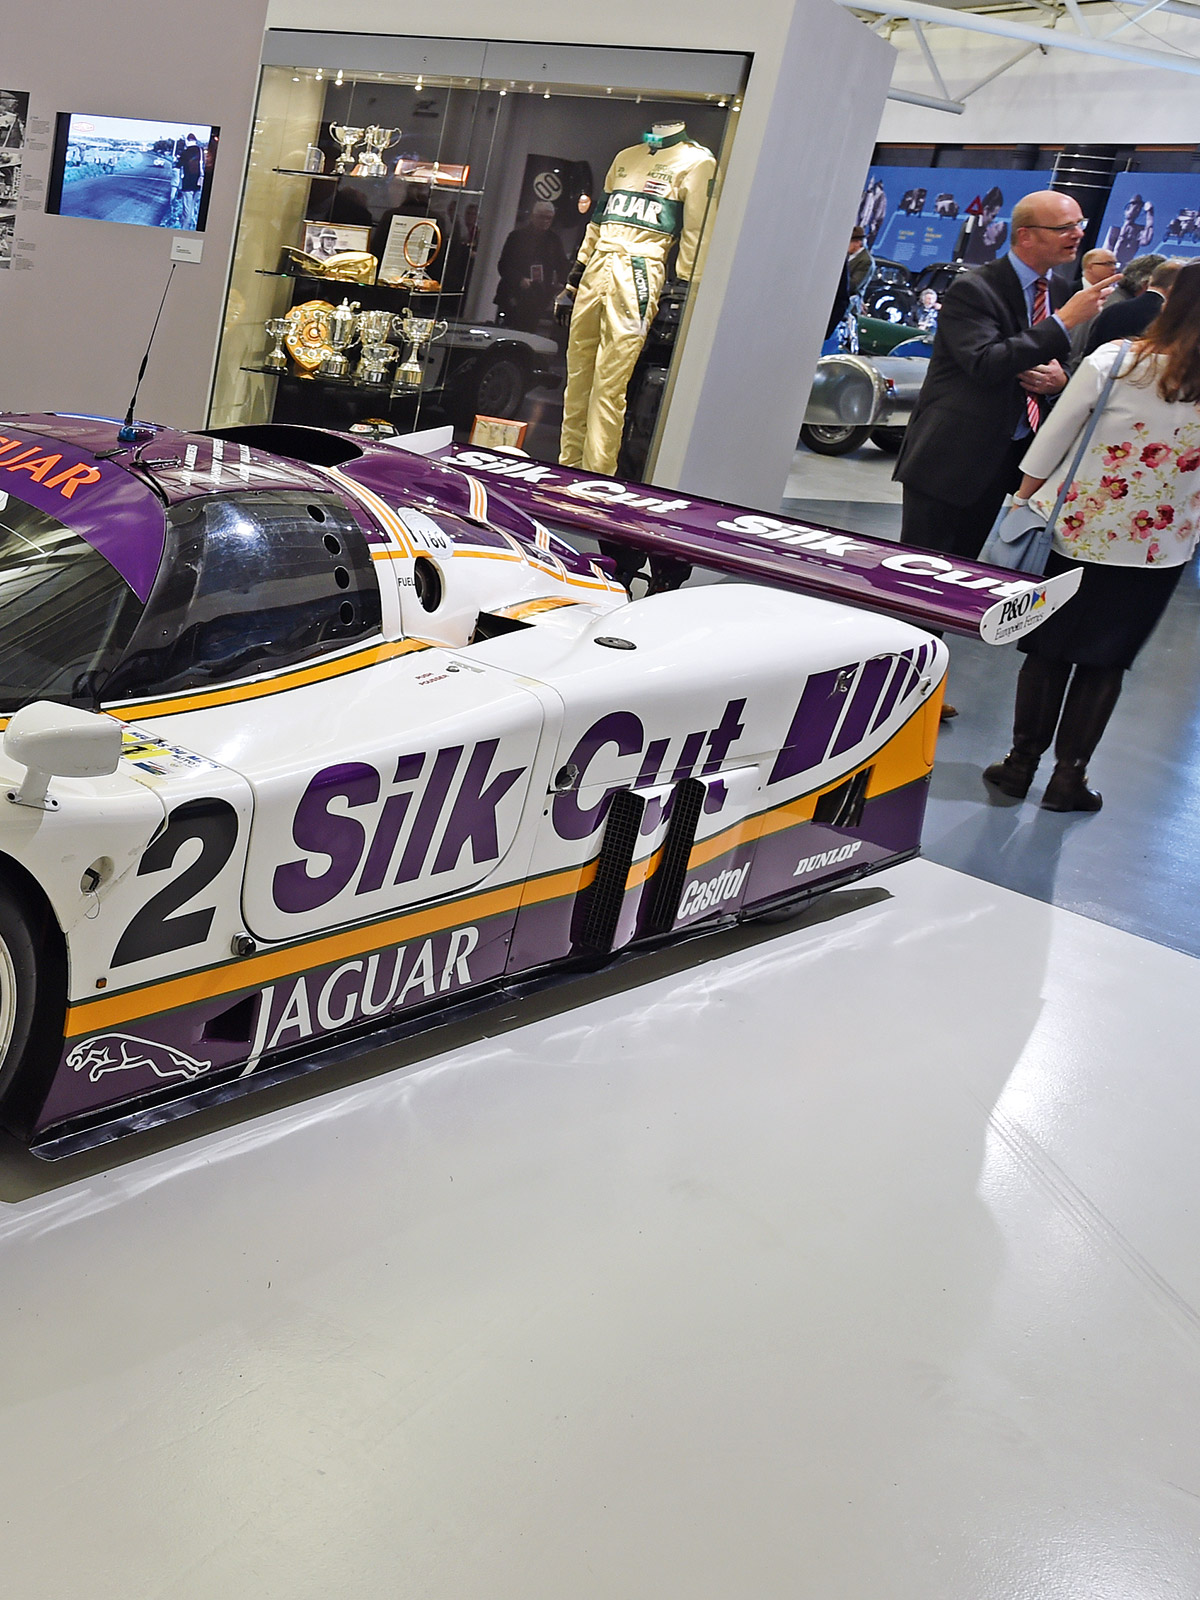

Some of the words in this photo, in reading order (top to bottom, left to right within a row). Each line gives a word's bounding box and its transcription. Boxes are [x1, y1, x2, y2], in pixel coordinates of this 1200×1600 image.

[634, 269, 648, 301] MOTUL
[440, 449, 560, 485] Silk
[576, 480, 695, 514] Cut
[397, 577, 416, 587] FUEL
[717, 514, 869, 558] Silk
[881, 554, 1041, 598] Cut
[994, 622, 1024, 641] European
[998, 593, 1030, 626] P&O
[271, 737, 526, 915] Silk
[551, 697, 747, 842] Cut
[111, 797, 239, 969] 2
[793, 840, 862, 878] DUNLOP
[676, 860, 751, 922] Castrol
[240, 926, 480, 1077] JAGUAR
